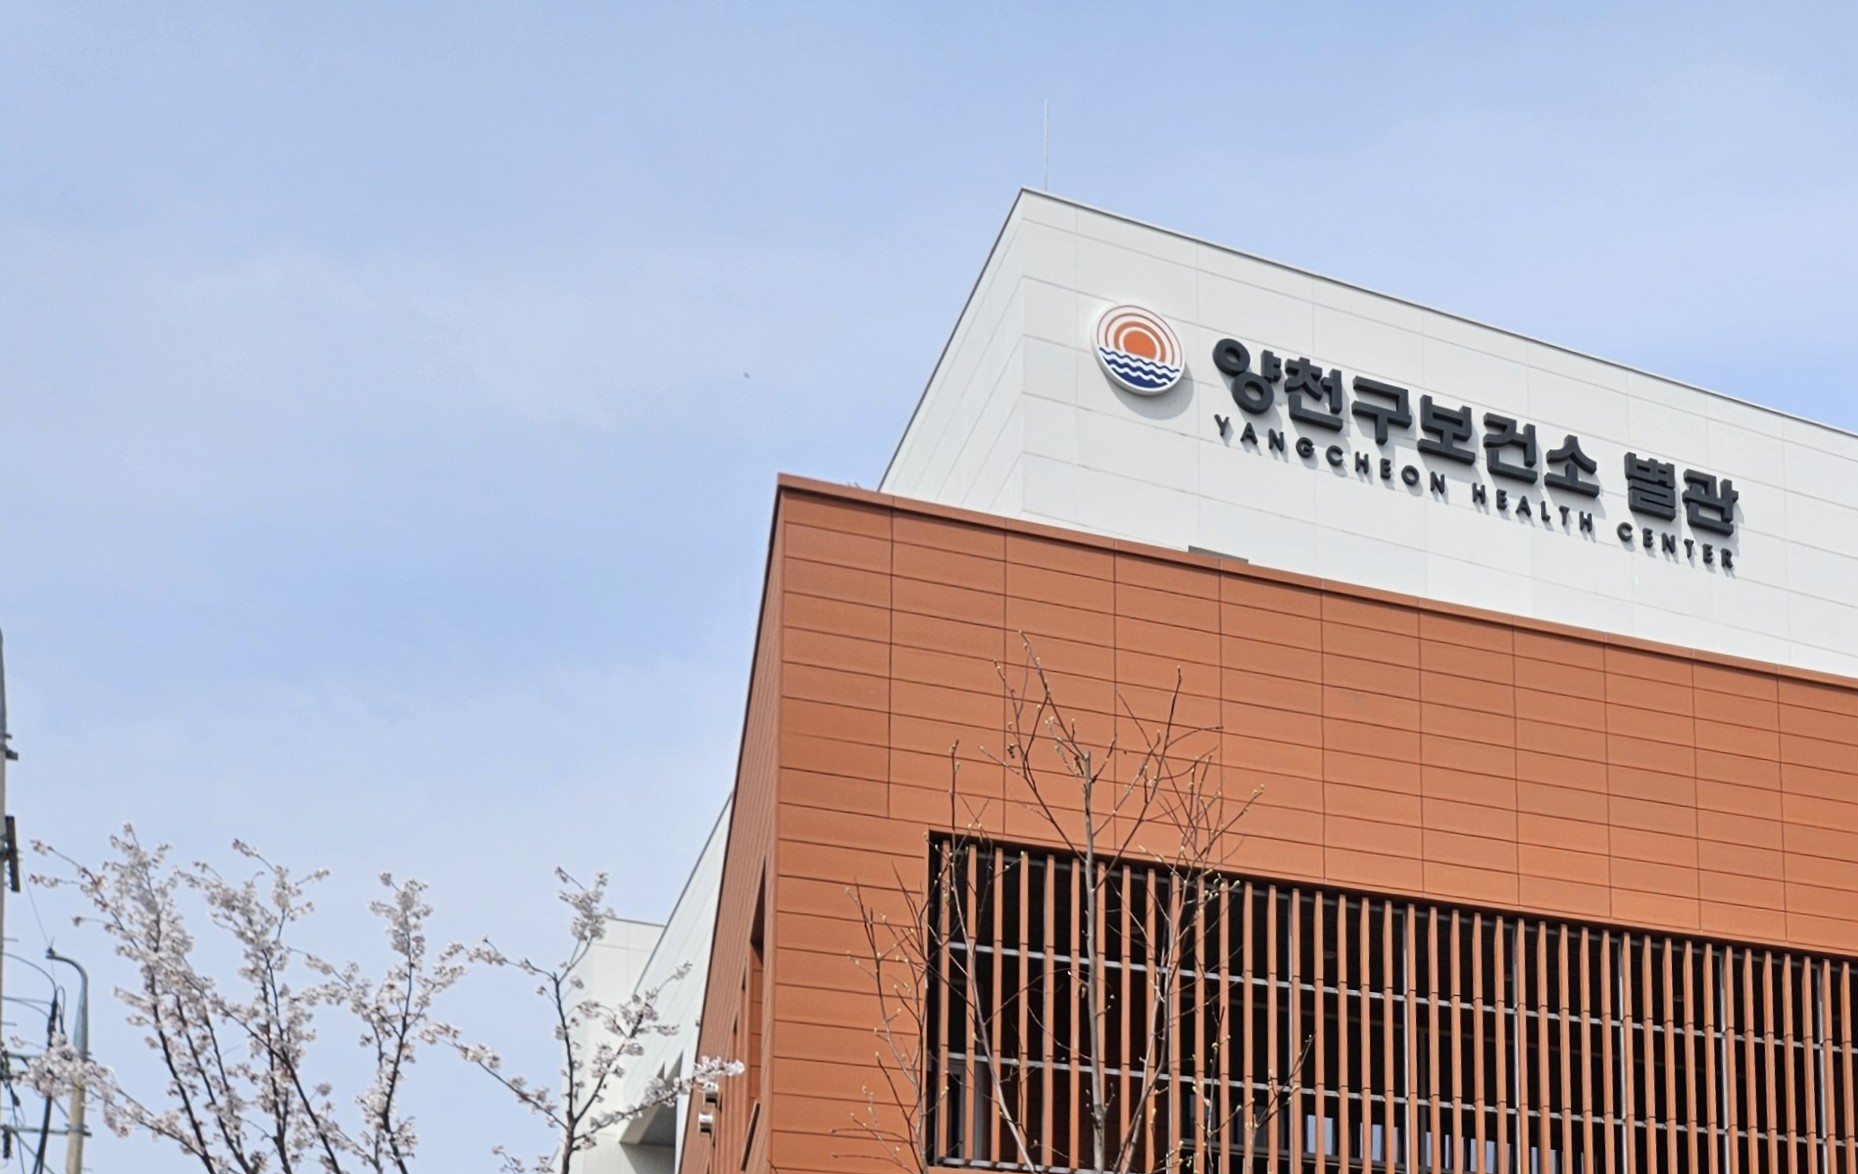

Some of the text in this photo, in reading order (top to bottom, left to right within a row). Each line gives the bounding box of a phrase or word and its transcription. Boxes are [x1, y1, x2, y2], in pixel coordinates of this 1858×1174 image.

[1212, 338, 1739, 537] 양천구보건소 별관
[1213, 413, 1736, 570] YANGCHEON HEALTH CENTER
